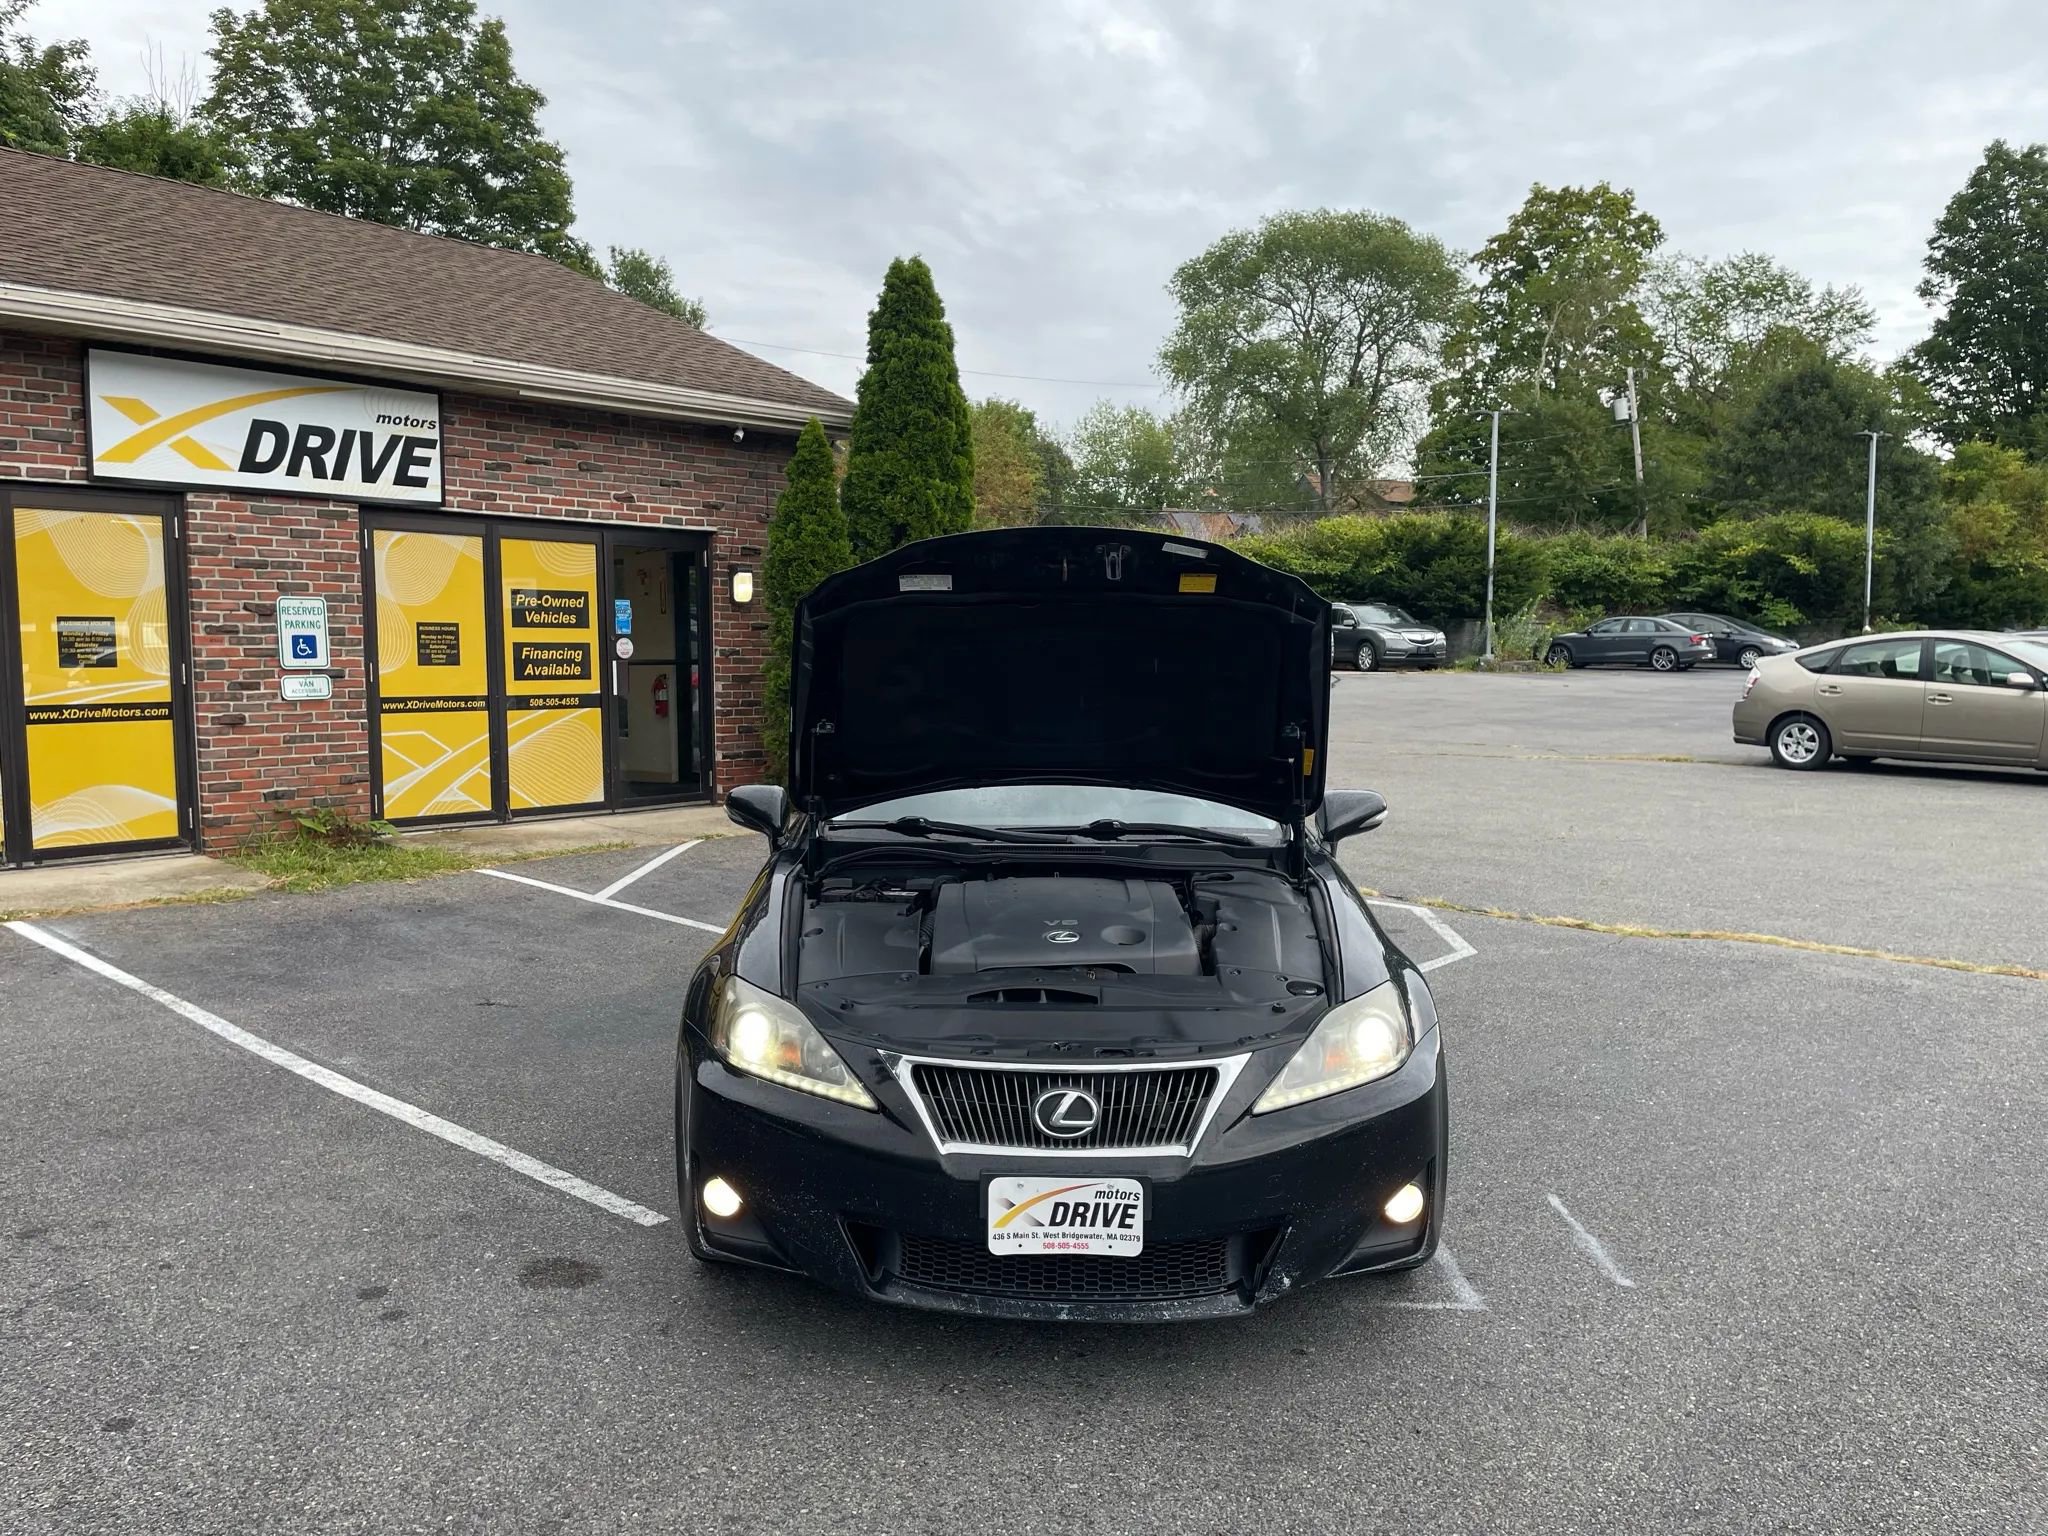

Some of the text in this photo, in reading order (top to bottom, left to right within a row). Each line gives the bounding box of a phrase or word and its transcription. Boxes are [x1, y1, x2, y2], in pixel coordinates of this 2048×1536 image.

[375, 411, 437, 430] motors
[238, 418, 438, 489] DRIVE
[515, 594, 584, 608] Pre-Owned
[281, 606, 323, 616] RESERVED
[524, 610, 577, 624] Vehicles
[284, 620, 321, 629] PARKING
[521, 647, 583, 661] Financing
[524, 663, 582, 676] Available
[382, 699, 486, 710] www.XDriveMotors.com
[529, 697, 579, 707] 508-505-4555
[29, 707, 169, 720] www.XDriveMotors.com
[1094, 1188, 1141, 1202] motors
[1048, 1201, 1139, 1230] DRIVE
[992, 1233, 1005, 1241] 436
[1006, 1232, 1011, 1240] S
[1061, 1231, 1105, 1241] Bridgewater,
[1119, 1233, 1141, 1242] 02379
[1042, 1242, 1089, 1250] 508-505-4555
